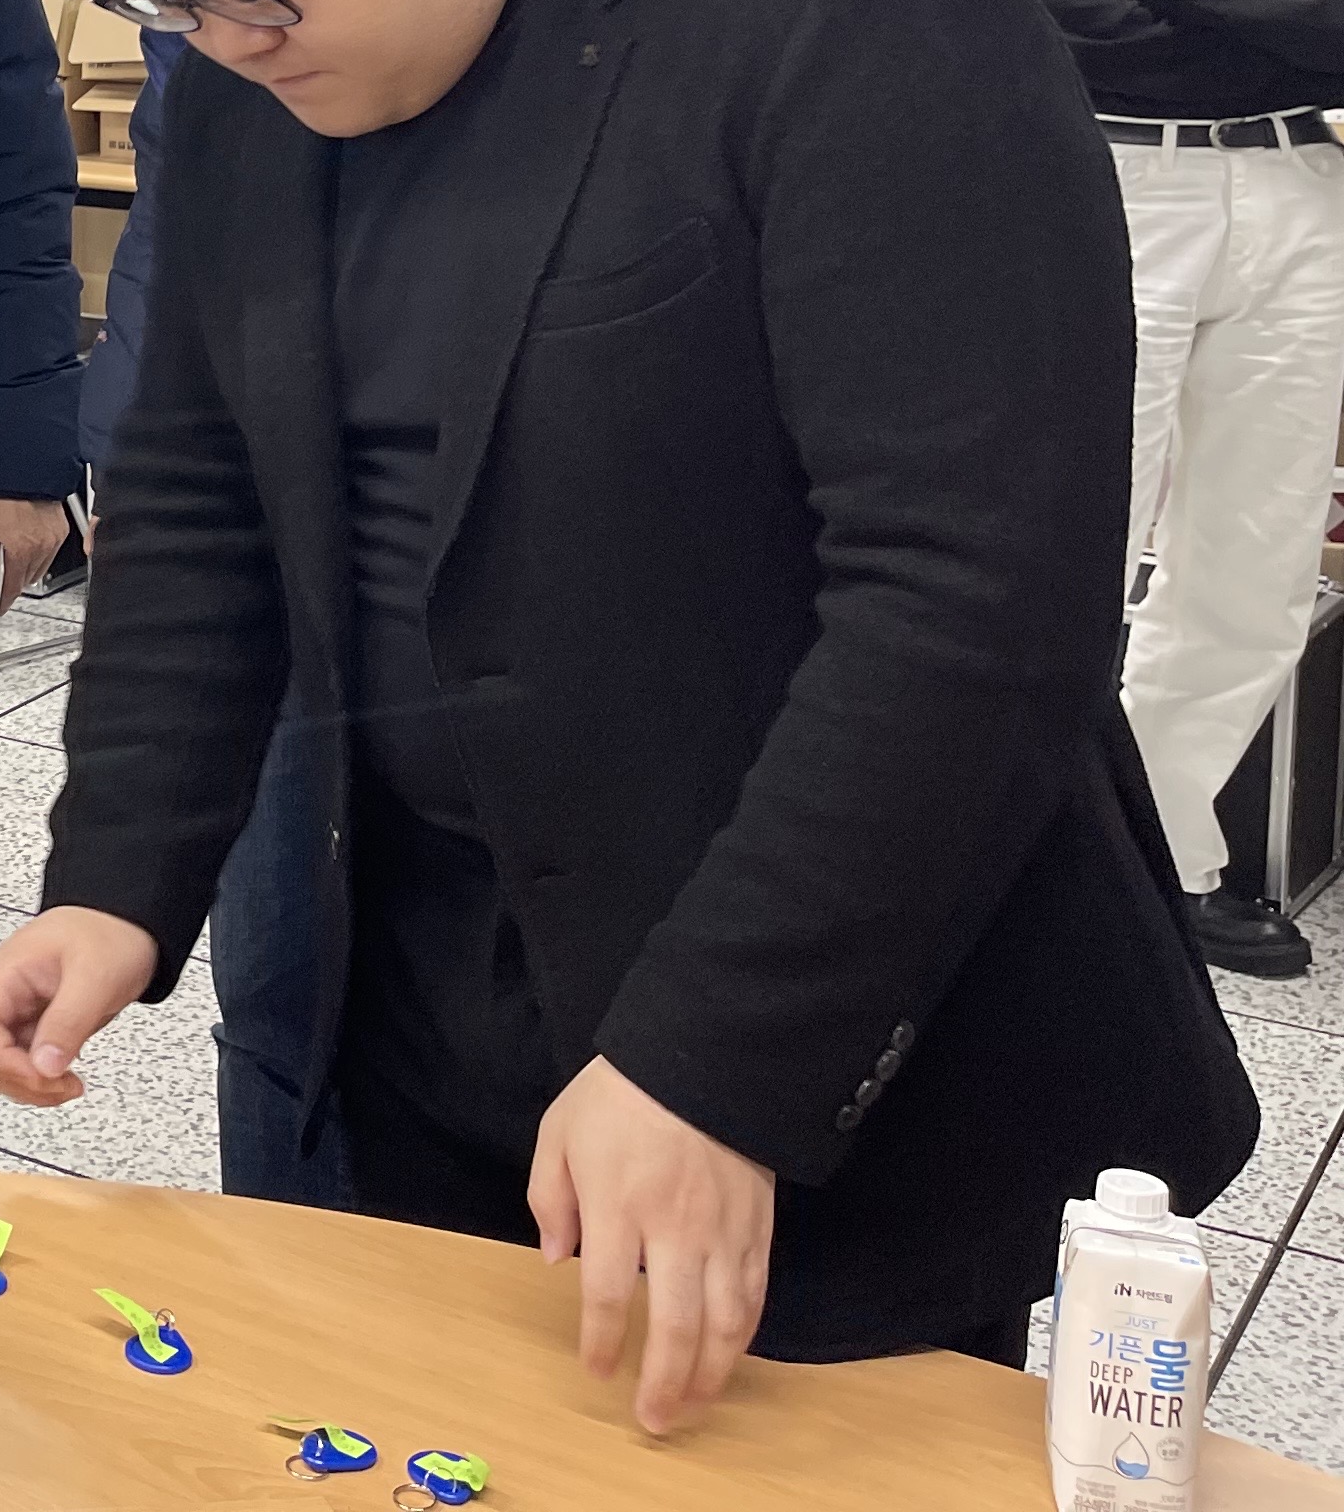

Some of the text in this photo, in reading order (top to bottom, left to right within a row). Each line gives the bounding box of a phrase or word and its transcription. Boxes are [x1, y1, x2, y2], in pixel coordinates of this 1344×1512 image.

[1125, 1315, 1159, 1330] JUST
[1090, 1360, 1133, 1385] DEEP
[1089, 1380, 1183, 1429] WATER
